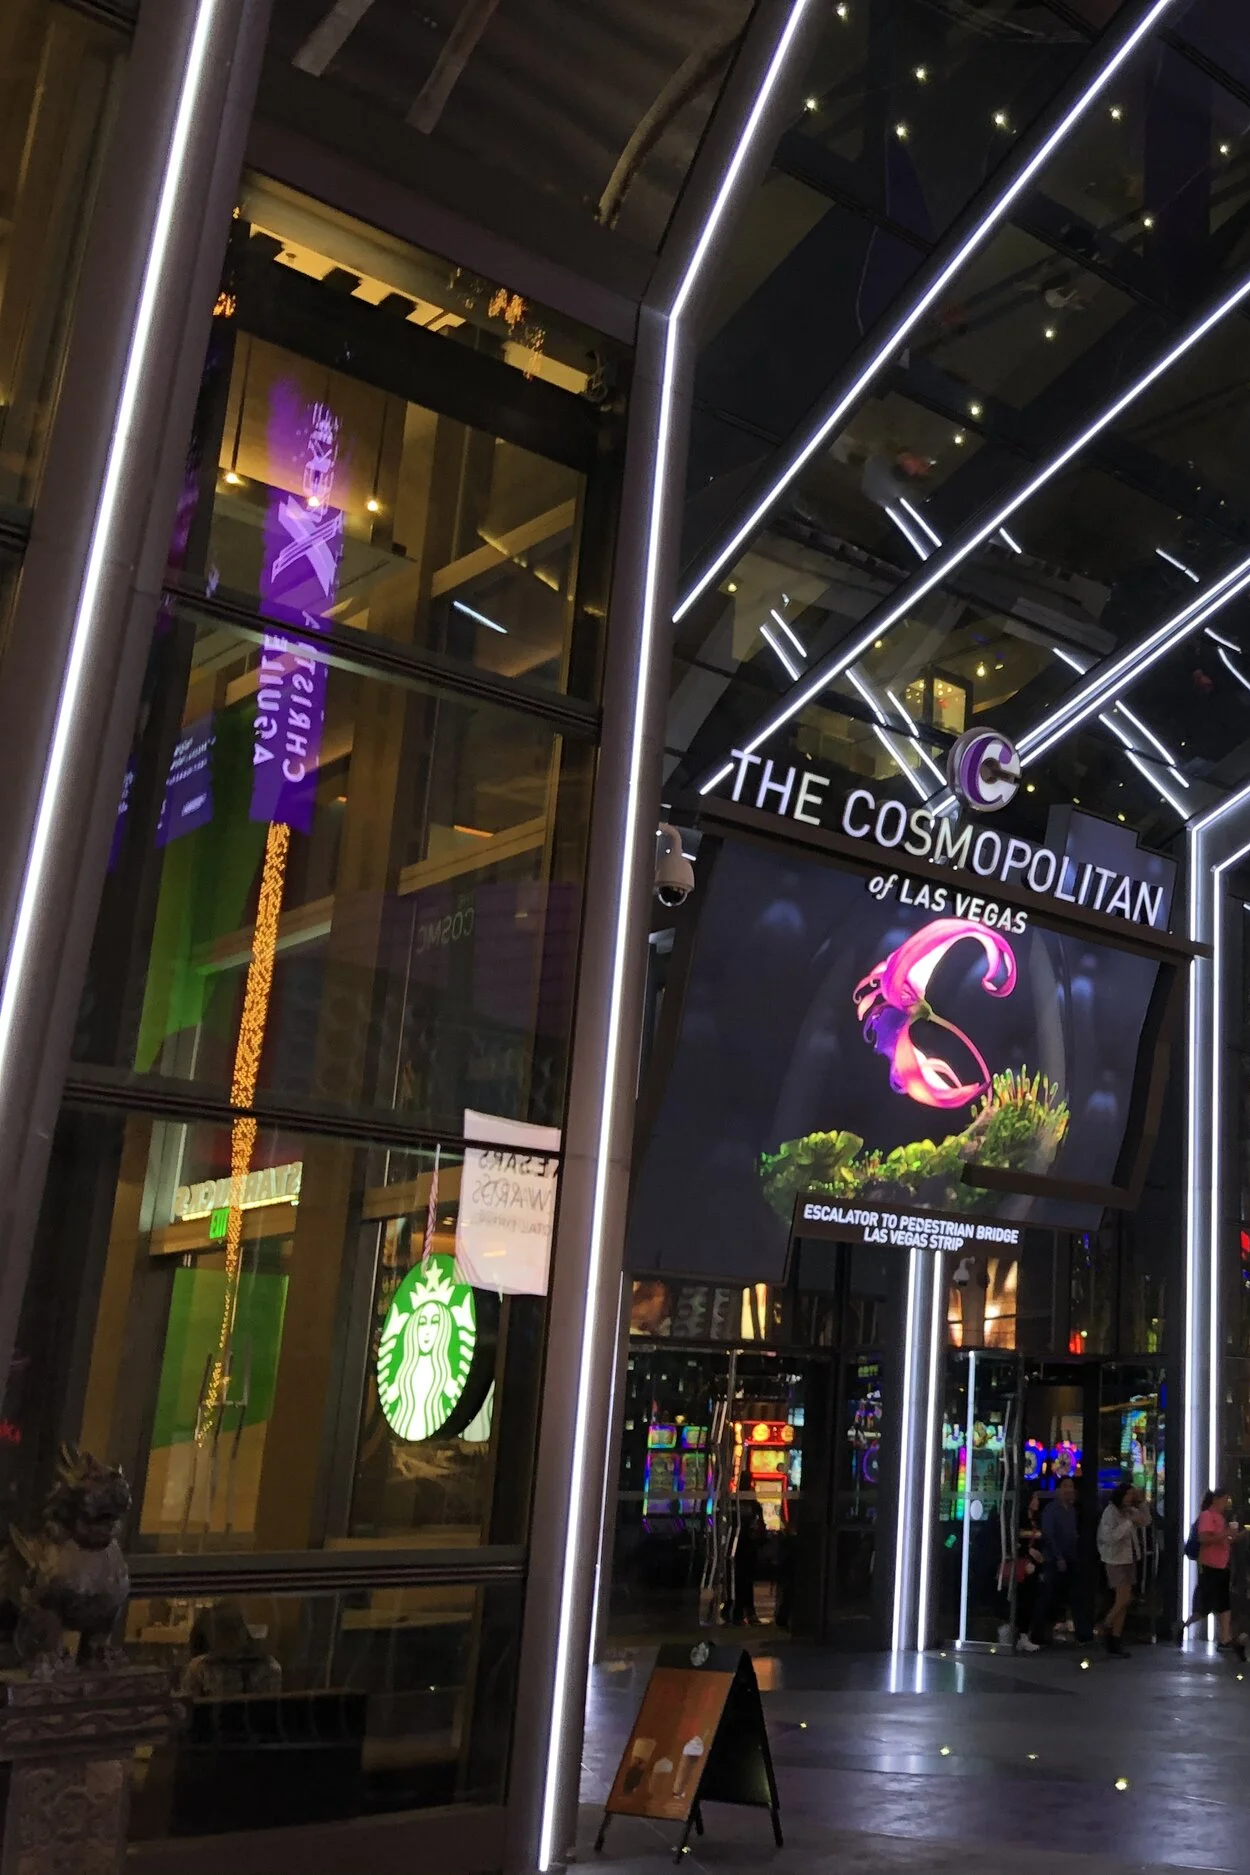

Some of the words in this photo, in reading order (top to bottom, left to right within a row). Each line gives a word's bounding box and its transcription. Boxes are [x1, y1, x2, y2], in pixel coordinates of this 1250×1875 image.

[729, 749, 831, 827] THE
[841, 789, 1165, 928] COSMOPOLITAN
[868, 872, 895, 900] of
[900, 879, 949, 914] LAS
[953, 893, 1029, 935] VEGAS
[803, 1203, 879, 1227] ESCALATOR
[881, 1212, 898, 1229] TO
[899, 1215, 975, 1239] PEDESTRIAN
[975, 1225, 1020, 1245] BRIDGE
[863, 1226, 889, 1244] LAS
[890, 1229, 929, 1249] VEGAS
[929, 1235, 964, 1252] STRIP
